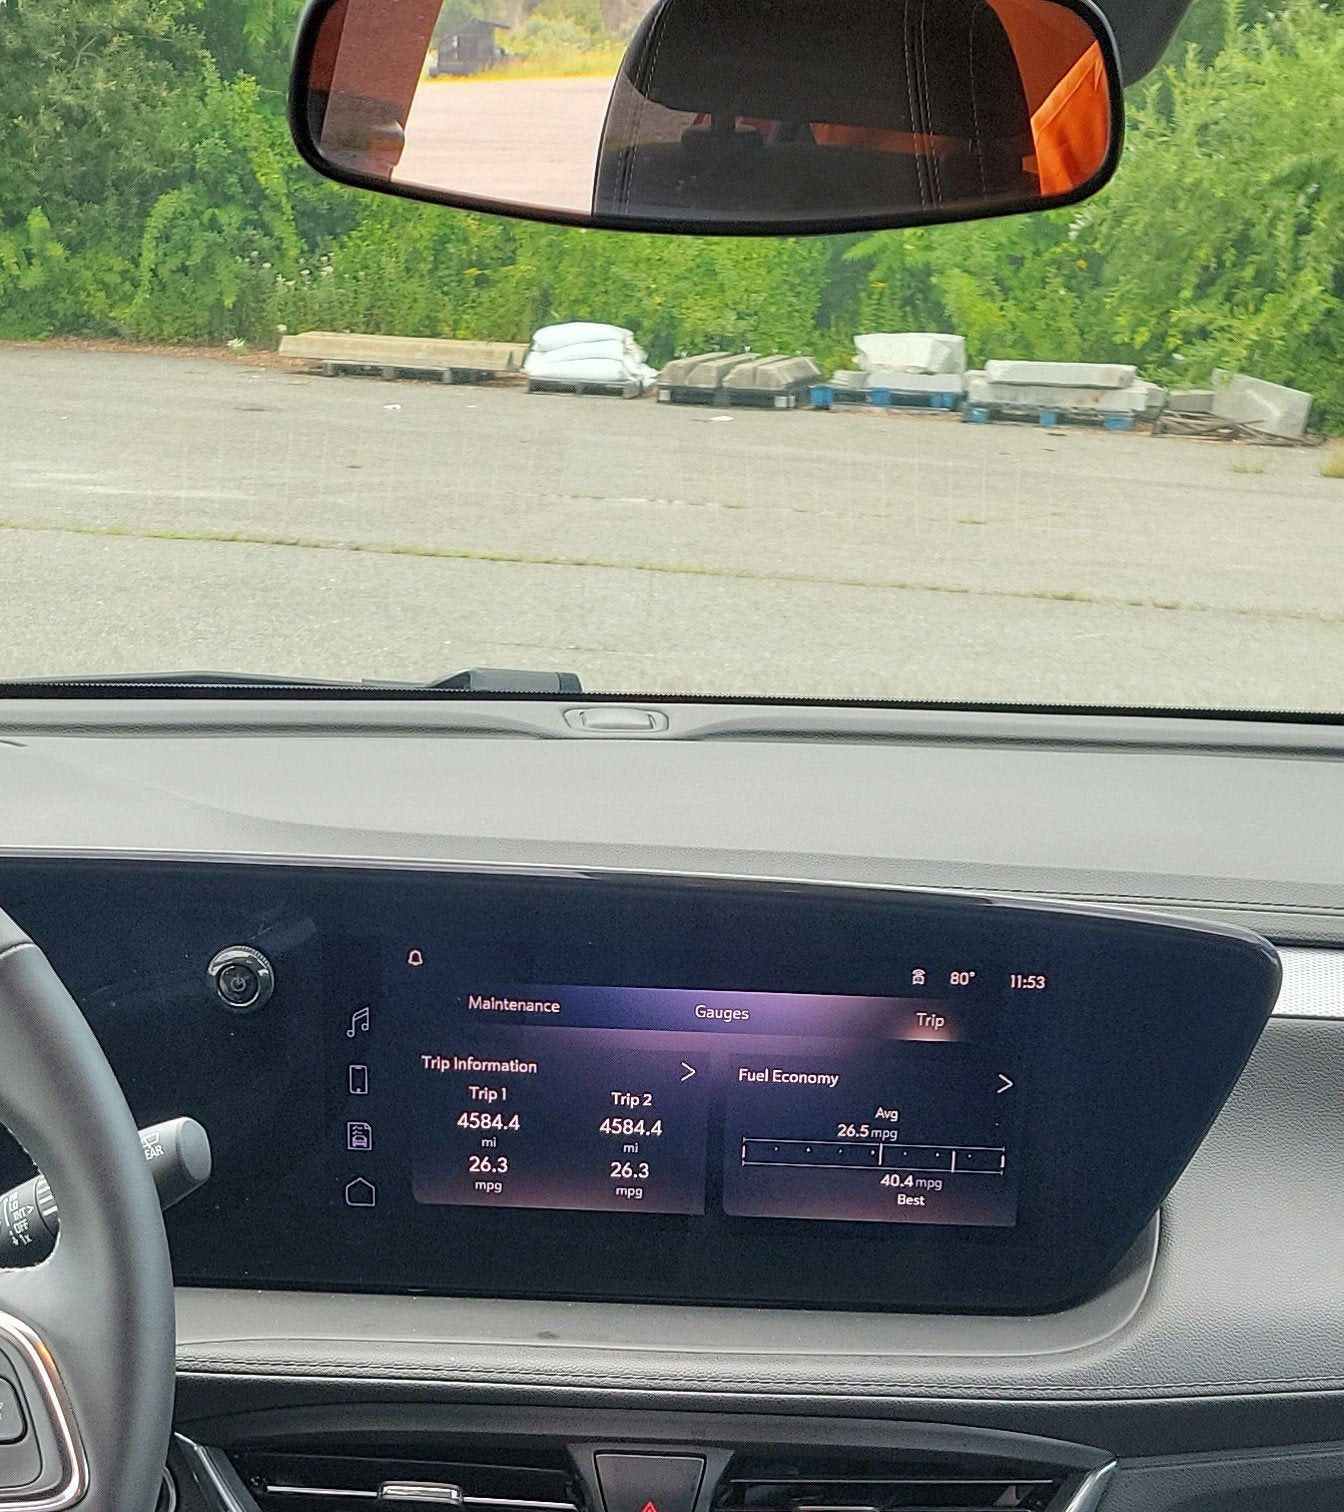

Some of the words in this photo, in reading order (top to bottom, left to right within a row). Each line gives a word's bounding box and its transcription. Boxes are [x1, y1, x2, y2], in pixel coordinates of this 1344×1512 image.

[949, 970, 977, 986] 80°
[1010, 974, 1047, 990] 11:53
[468, 994, 561, 1014] Maintenance
[695, 1004, 750, 1024] Gauges
[916, 1011, 945, 1030] Trip
[421, 1055, 451, 1073] Trip
[453, 1056, 538, 1075] Information
[738, 1067, 770, 1083] Fuel
[773, 1069, 839, 1088] Economy
[468, 1086, 498, 1105] Trip
[501, 1087, 507, 1101] 1
[611, 1091, 641, 1110] Trip
[642, 1093, 653, 1107] 2
[456, 1112, 521, 1132] 4584.4
[874, 1106, 899, 1122] Avg
[599, 1117, 663, 1137] 4584.4
[837, 1123, 869, 1139] 26.5
[870, 1128, 898, 1142] mpg
[481, 1136, 497, 1148] mi
[623, 1142, 639, 1154] mi
[144, 1144, 164, 1161] EAR
[468, 1155, 509, 1174] 26.3
[610, 1160, 651, 1180] 26.3
[474, 1181, 503, 1194] mpg
[880, 1173, 914, 1188] 40.4
[915, 1177, 943, 1191] mpg
[615, 1186, 643, 1200] mpg
[897, 1192, 926, 1207] Best
[13, 1218, 29, 1234] OFF
